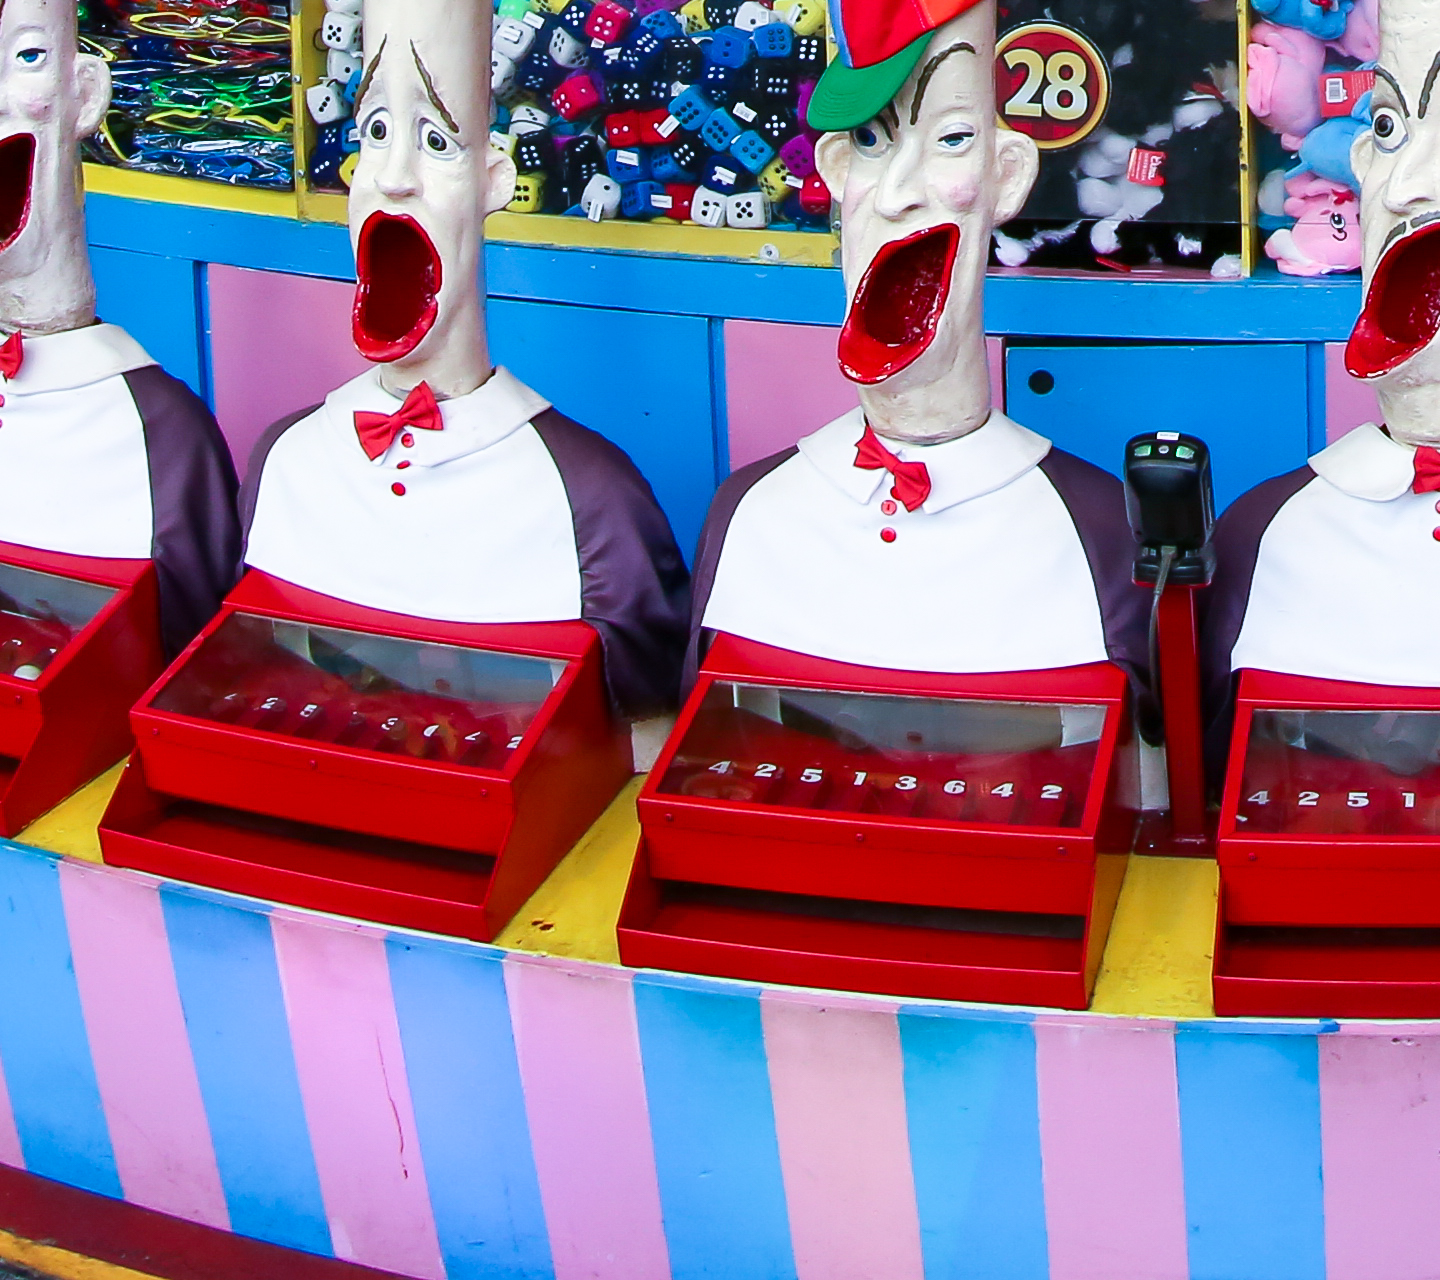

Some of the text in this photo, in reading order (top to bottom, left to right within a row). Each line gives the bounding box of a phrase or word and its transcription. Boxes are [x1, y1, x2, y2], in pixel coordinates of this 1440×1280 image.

[1003, 48, 1089, 119] 28
[1247, 791, 1270, 806] 4
[1298, 791, 1320, 806] 2
[1347, 792, 1369, 808] 5
[1402, 792, 1416, 808] 1
